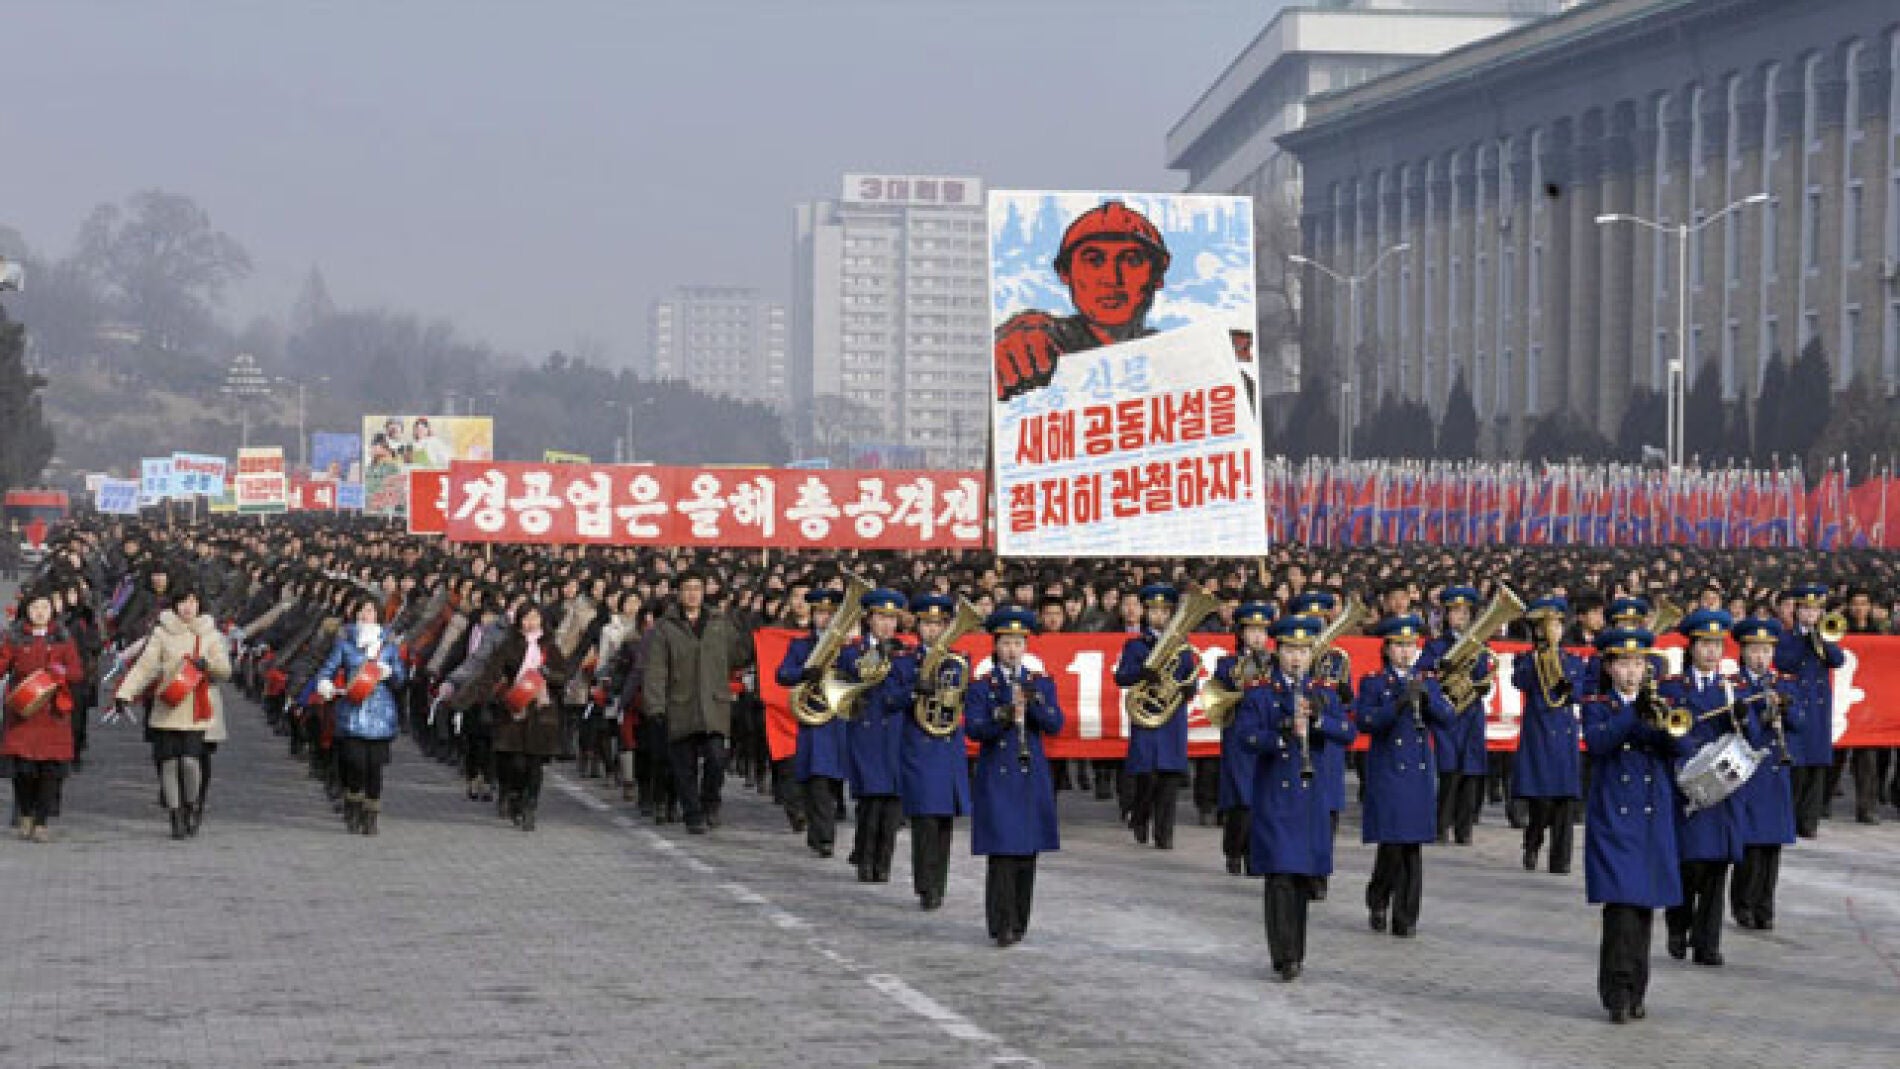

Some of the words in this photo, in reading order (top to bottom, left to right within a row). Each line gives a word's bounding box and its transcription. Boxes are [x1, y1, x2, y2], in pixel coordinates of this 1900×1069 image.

[1015, 409, 1076, 466] 새해
[1083, 383, 1236, 456] 공동사설을
[452, 468, 669, 539] 경공업은
[676, 473, 776, 539] 올해
[785, 474, 996, 541] 총공격전
[1009, 472, 1103, 534] 철저히
[1111, 447, 1254, 518] 관철하자!
